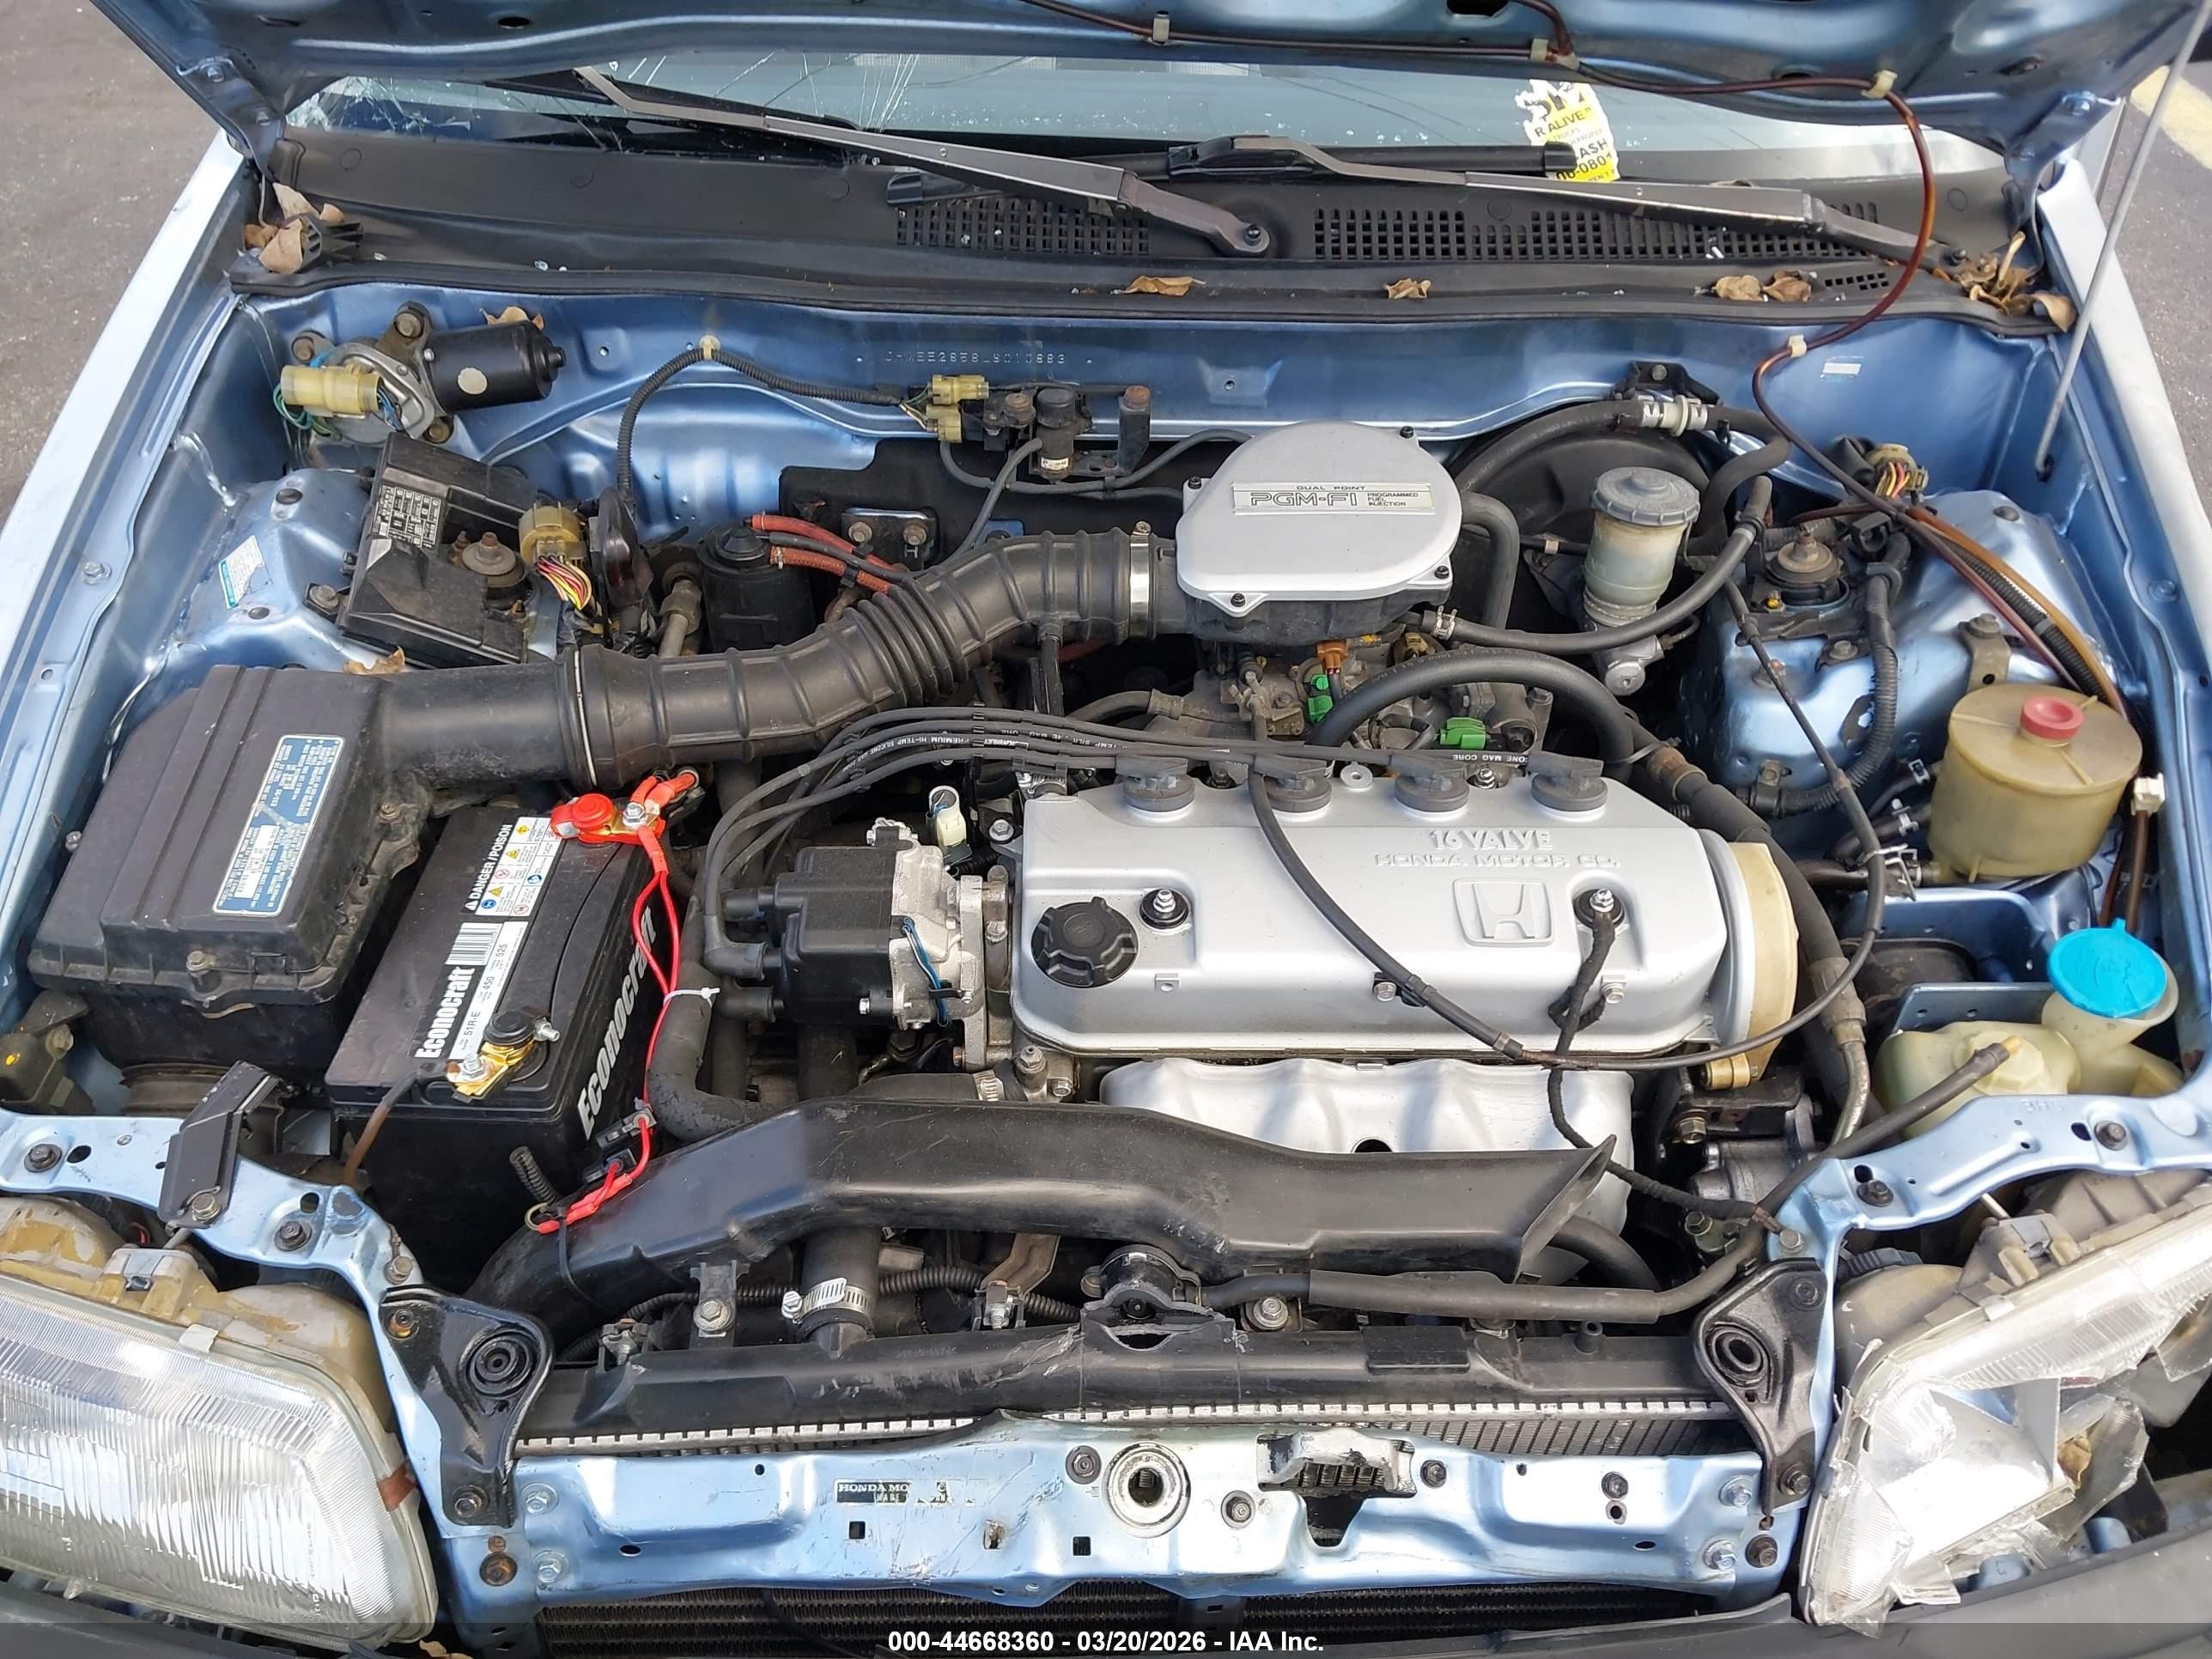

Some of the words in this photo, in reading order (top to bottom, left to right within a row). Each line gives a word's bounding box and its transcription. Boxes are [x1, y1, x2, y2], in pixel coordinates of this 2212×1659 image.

[1250, 492, 1358, 507] PGM-FI
[1374, 854, 1468, 867] HONDA
[1474, 854, 1571, 867] MOTOR
[495, 944, 507, 957] 525
[414, 966, 476, 1058] Econocraft
[838, 1483, 887, 1492] HONDA
